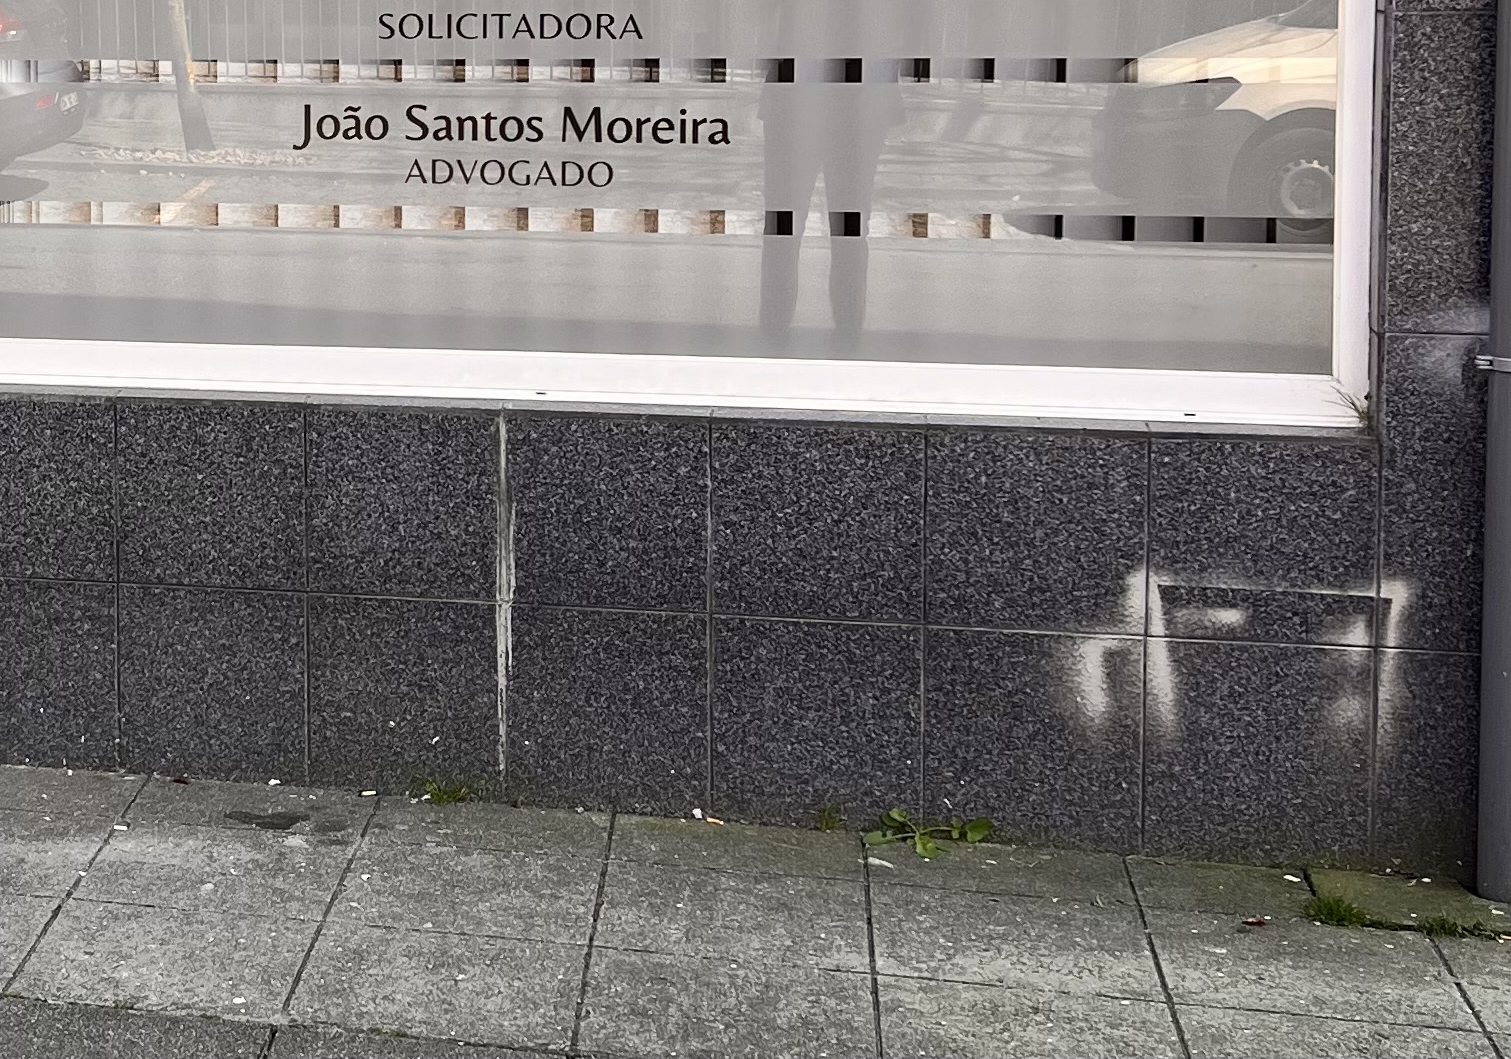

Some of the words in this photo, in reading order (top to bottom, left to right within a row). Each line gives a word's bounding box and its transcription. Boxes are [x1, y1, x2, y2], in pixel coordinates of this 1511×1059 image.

[378, 12, 644, 41] SOLICITADORA
[293, 103, 389, 151] João
[404, 103, 544, 143] Santos
[561, 105, 732, 146] Moreira
[404, 157, 614, 189] ADVOGADO
